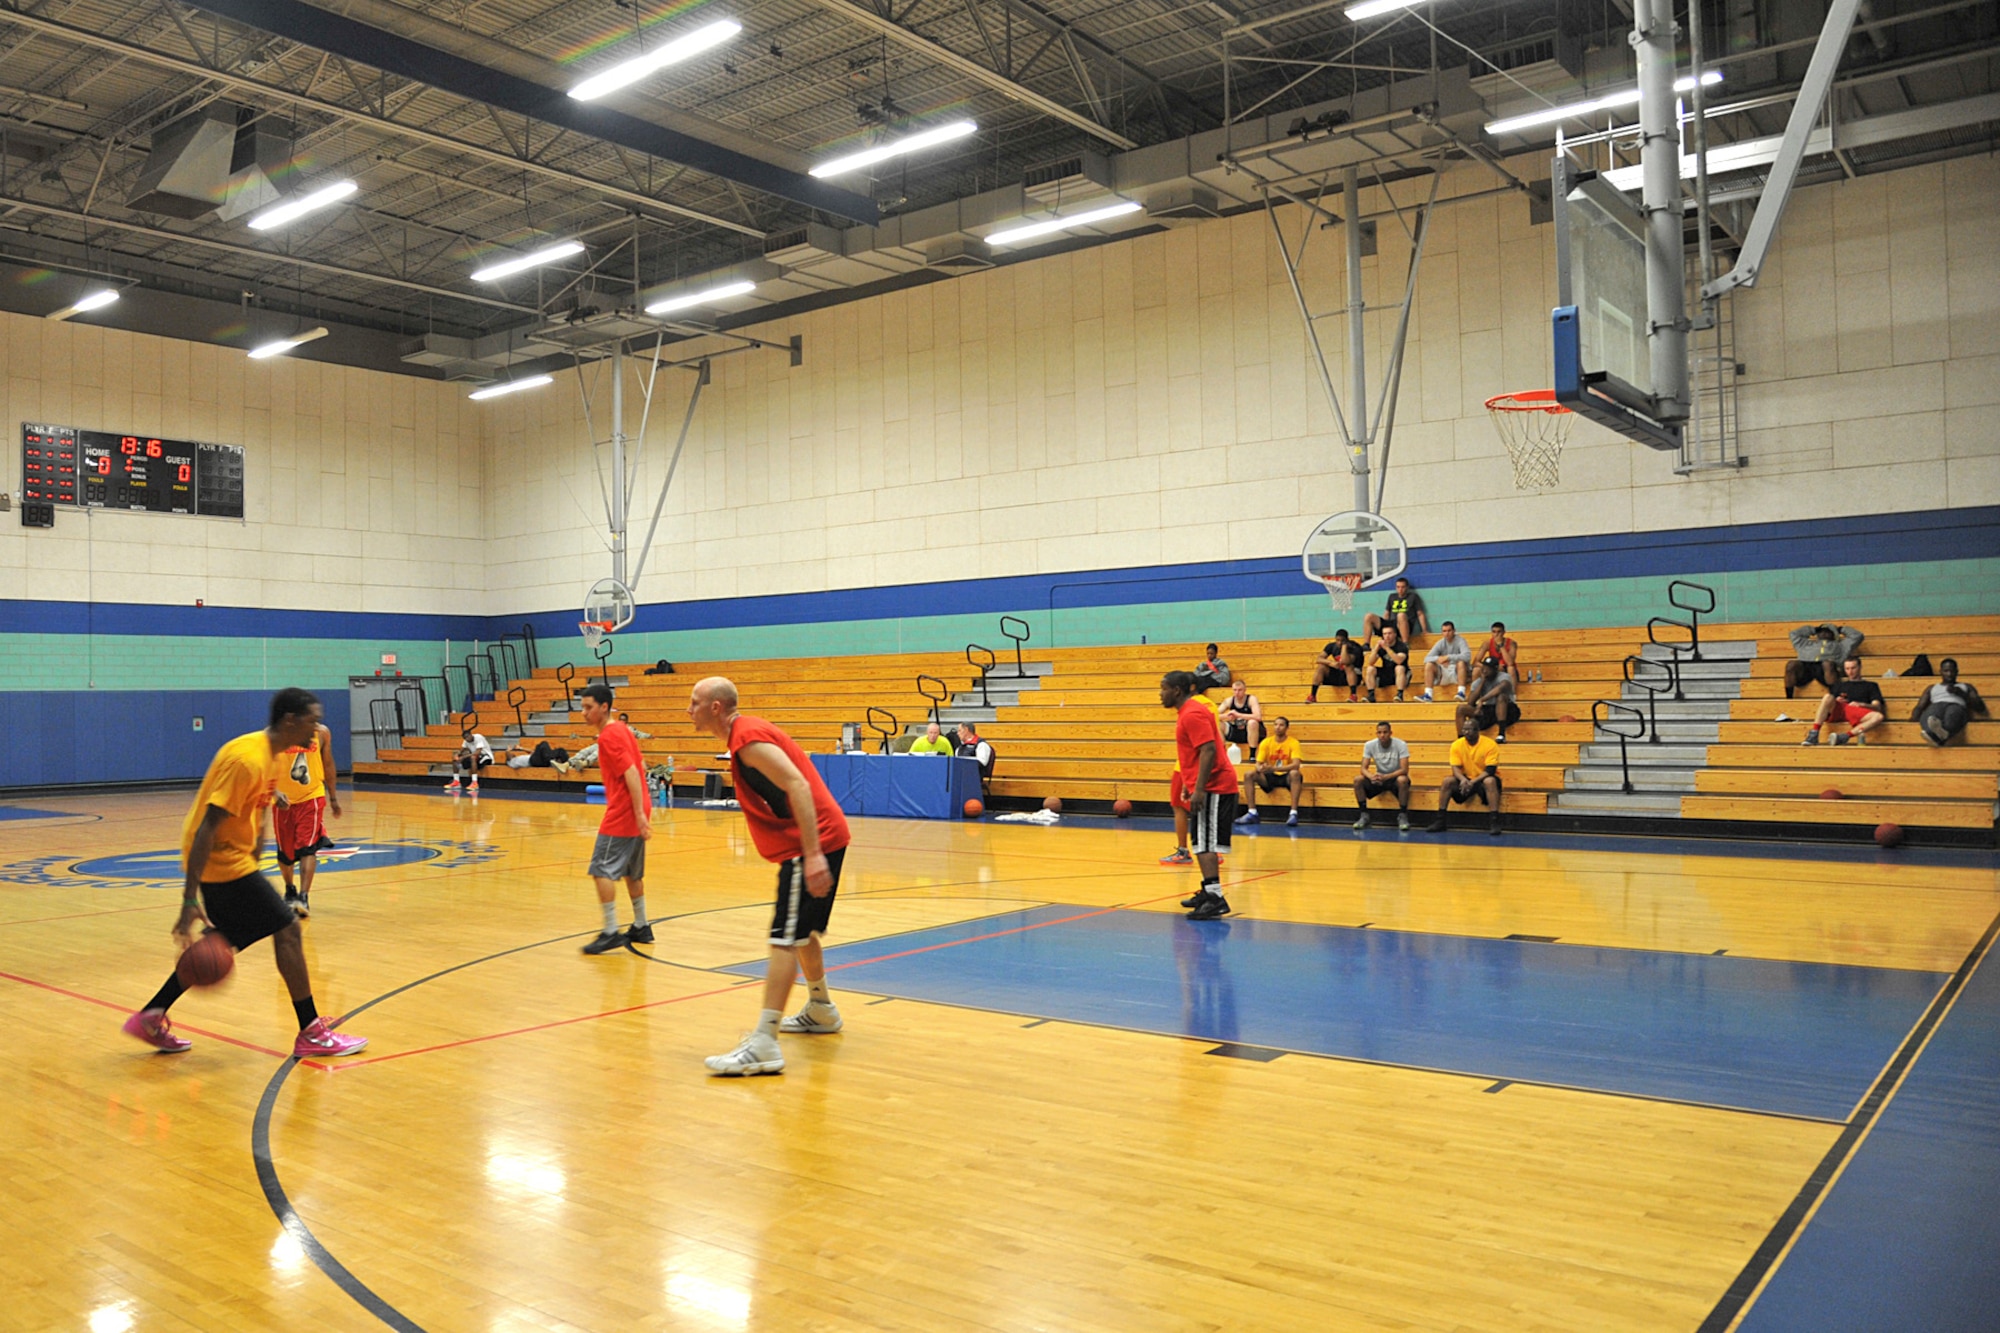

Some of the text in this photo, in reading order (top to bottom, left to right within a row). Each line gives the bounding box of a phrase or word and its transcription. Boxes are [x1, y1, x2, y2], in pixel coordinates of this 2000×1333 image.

[60, 428, 74, 436] PTS
[85, 447, 110, 457] HOME
[199, 443, 216, 452] PLYR
[165, 455, 191, 465] GUEST
[98, 456, 111, 475] 0
[178, 464, 190, 482] 0
